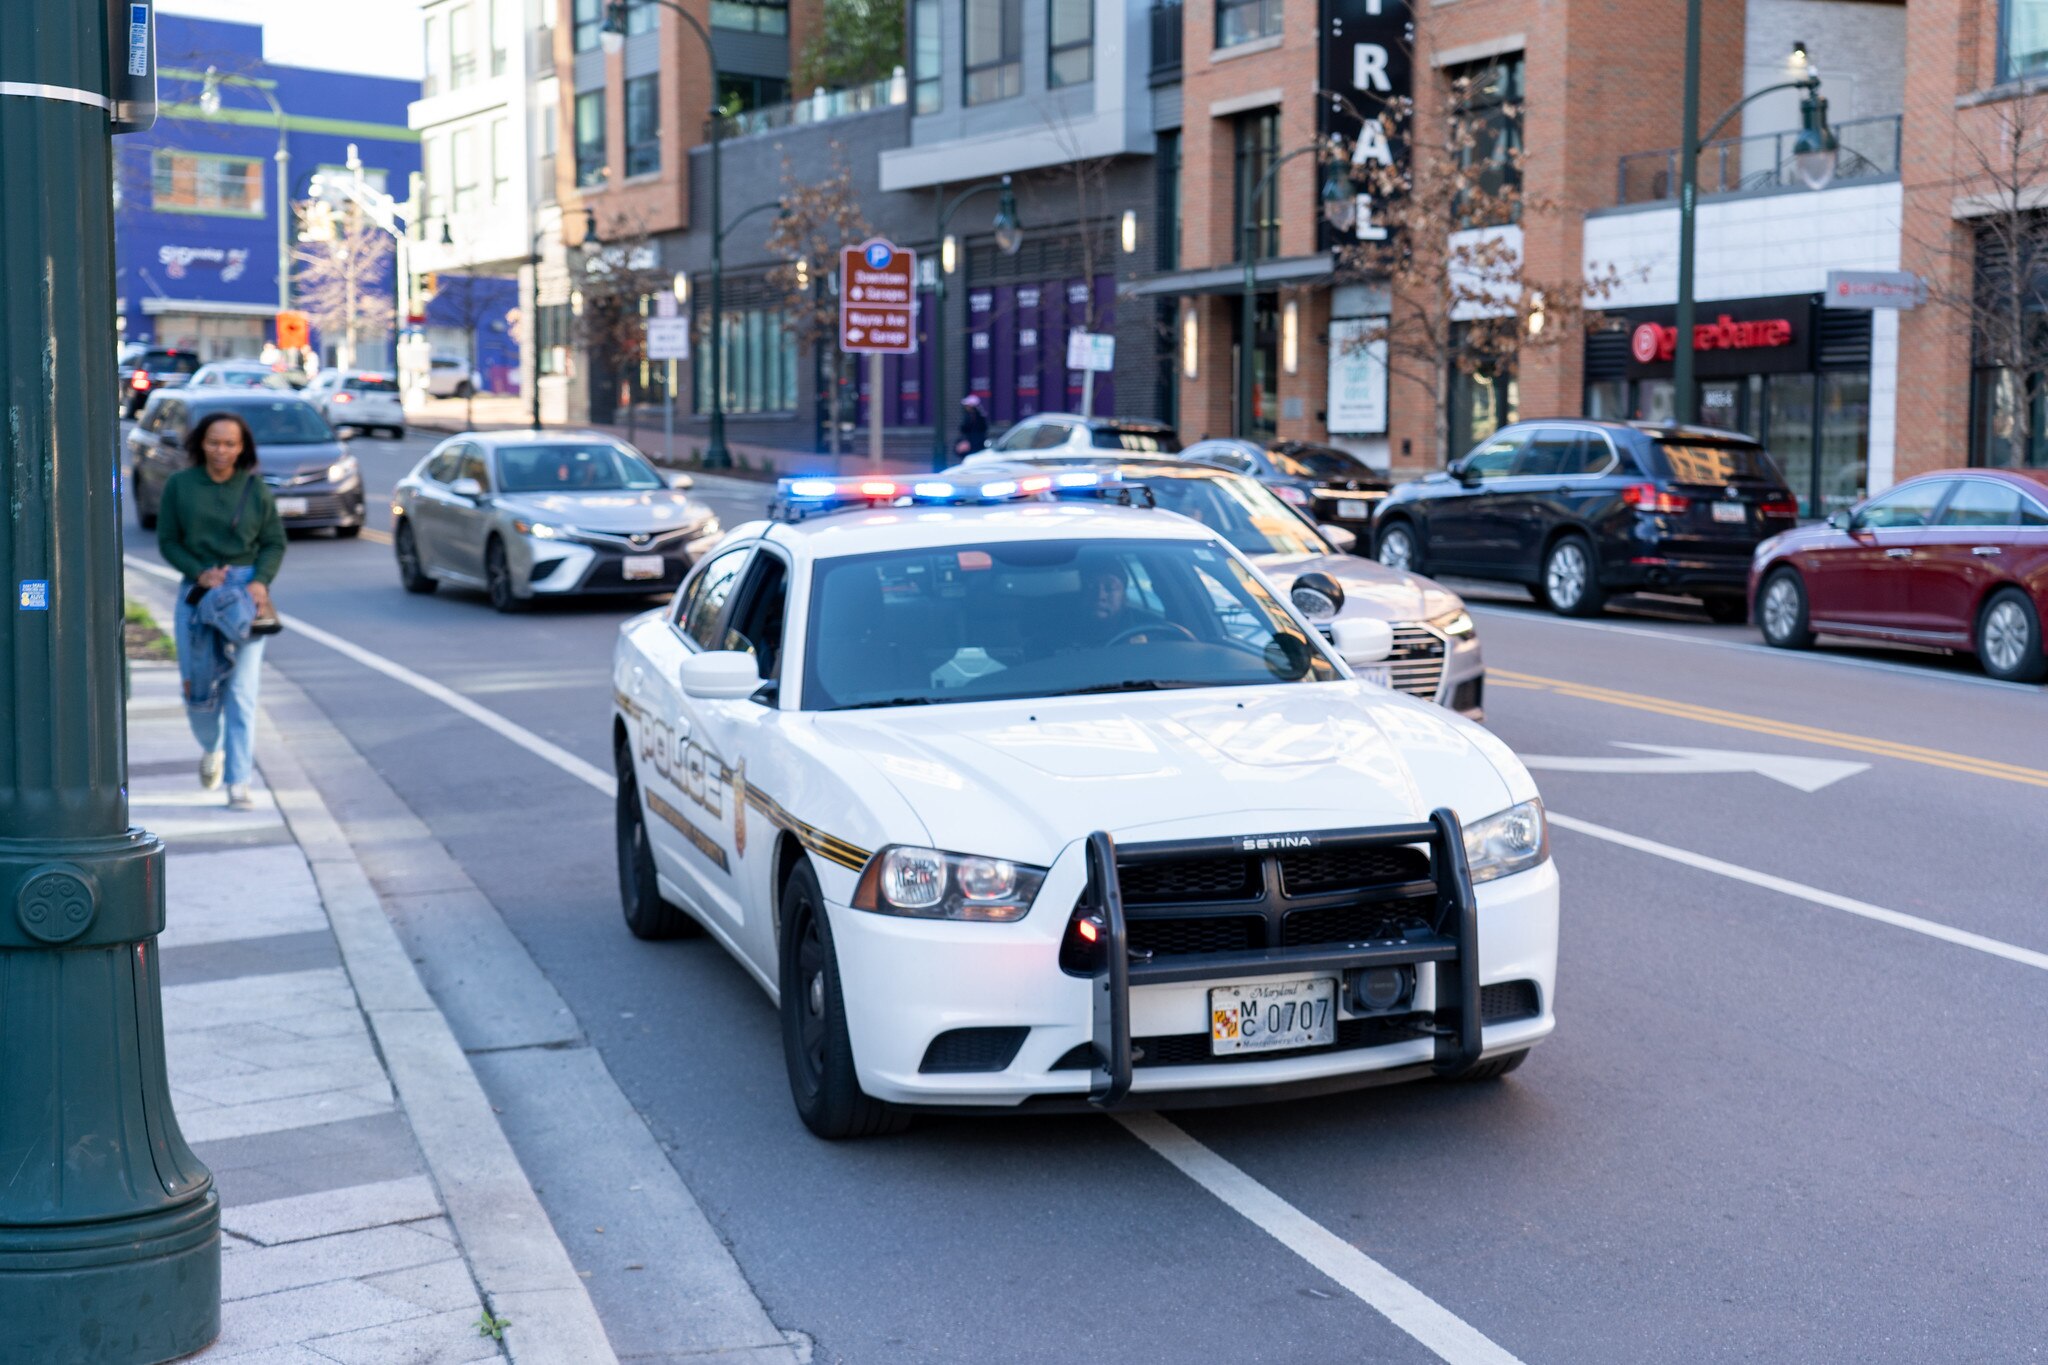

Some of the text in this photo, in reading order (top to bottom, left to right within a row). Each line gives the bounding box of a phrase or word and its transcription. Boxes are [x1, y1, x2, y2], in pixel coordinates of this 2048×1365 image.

[871, 244, 888, 265] P
[640, 709, 722, 821] POLICE
[1243, 836, 1311, 850] SETINA
[1250, 984, 1298, 1000] Maryland
[1268, 998, 1329, 1034] 0707
